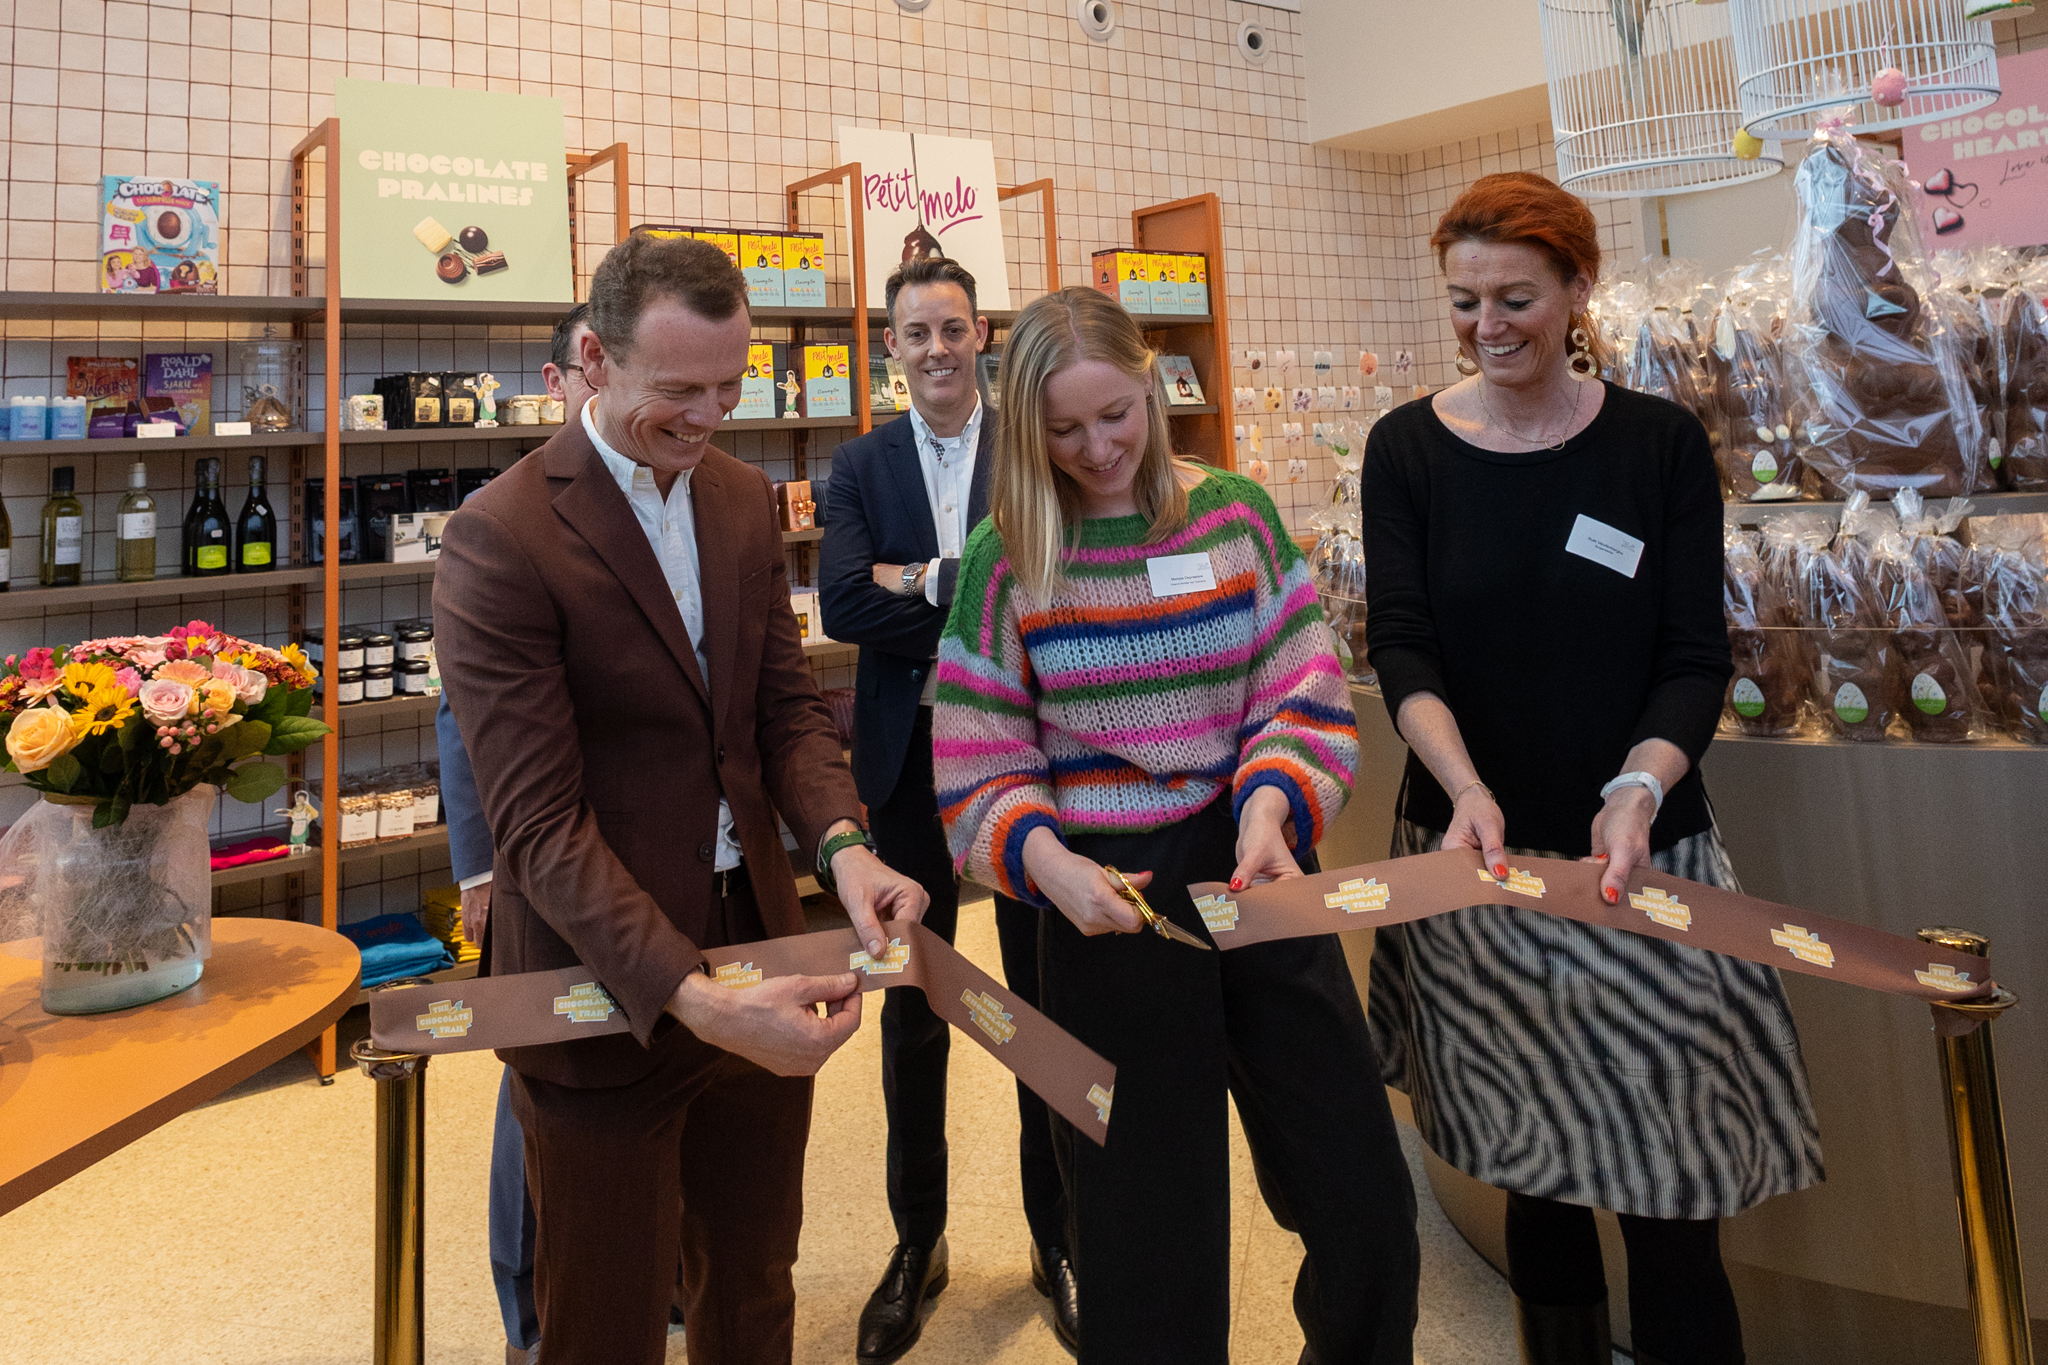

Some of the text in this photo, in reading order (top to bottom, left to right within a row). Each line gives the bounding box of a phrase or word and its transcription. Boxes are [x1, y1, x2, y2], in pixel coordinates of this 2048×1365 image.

[1920, 105, 2048, 142] CHOCOL
[358, 149, 548, 182] CHOCOLATE
[378, 178, 533, 206] PRALINES
[864, 168, 976, 226] Petit melo
[160, 355, 201, 368] ROALD
[163, 367, 198, 378] DAHL
[163, 380, 192, 390] SJAKIE
[1343, 882, 1361, 891] THE
[1328, 887, 1385, 903] CHOCOLATE
[1353, 899, 1380, 908] TRAIL
[873, 961, 900, 970] TRAIL
[432, 1003, 449, 1013] THE
[419, 1012, 469, 1026] CHOCOLATE
[440, 1025, 465, 1033] TRAIL
